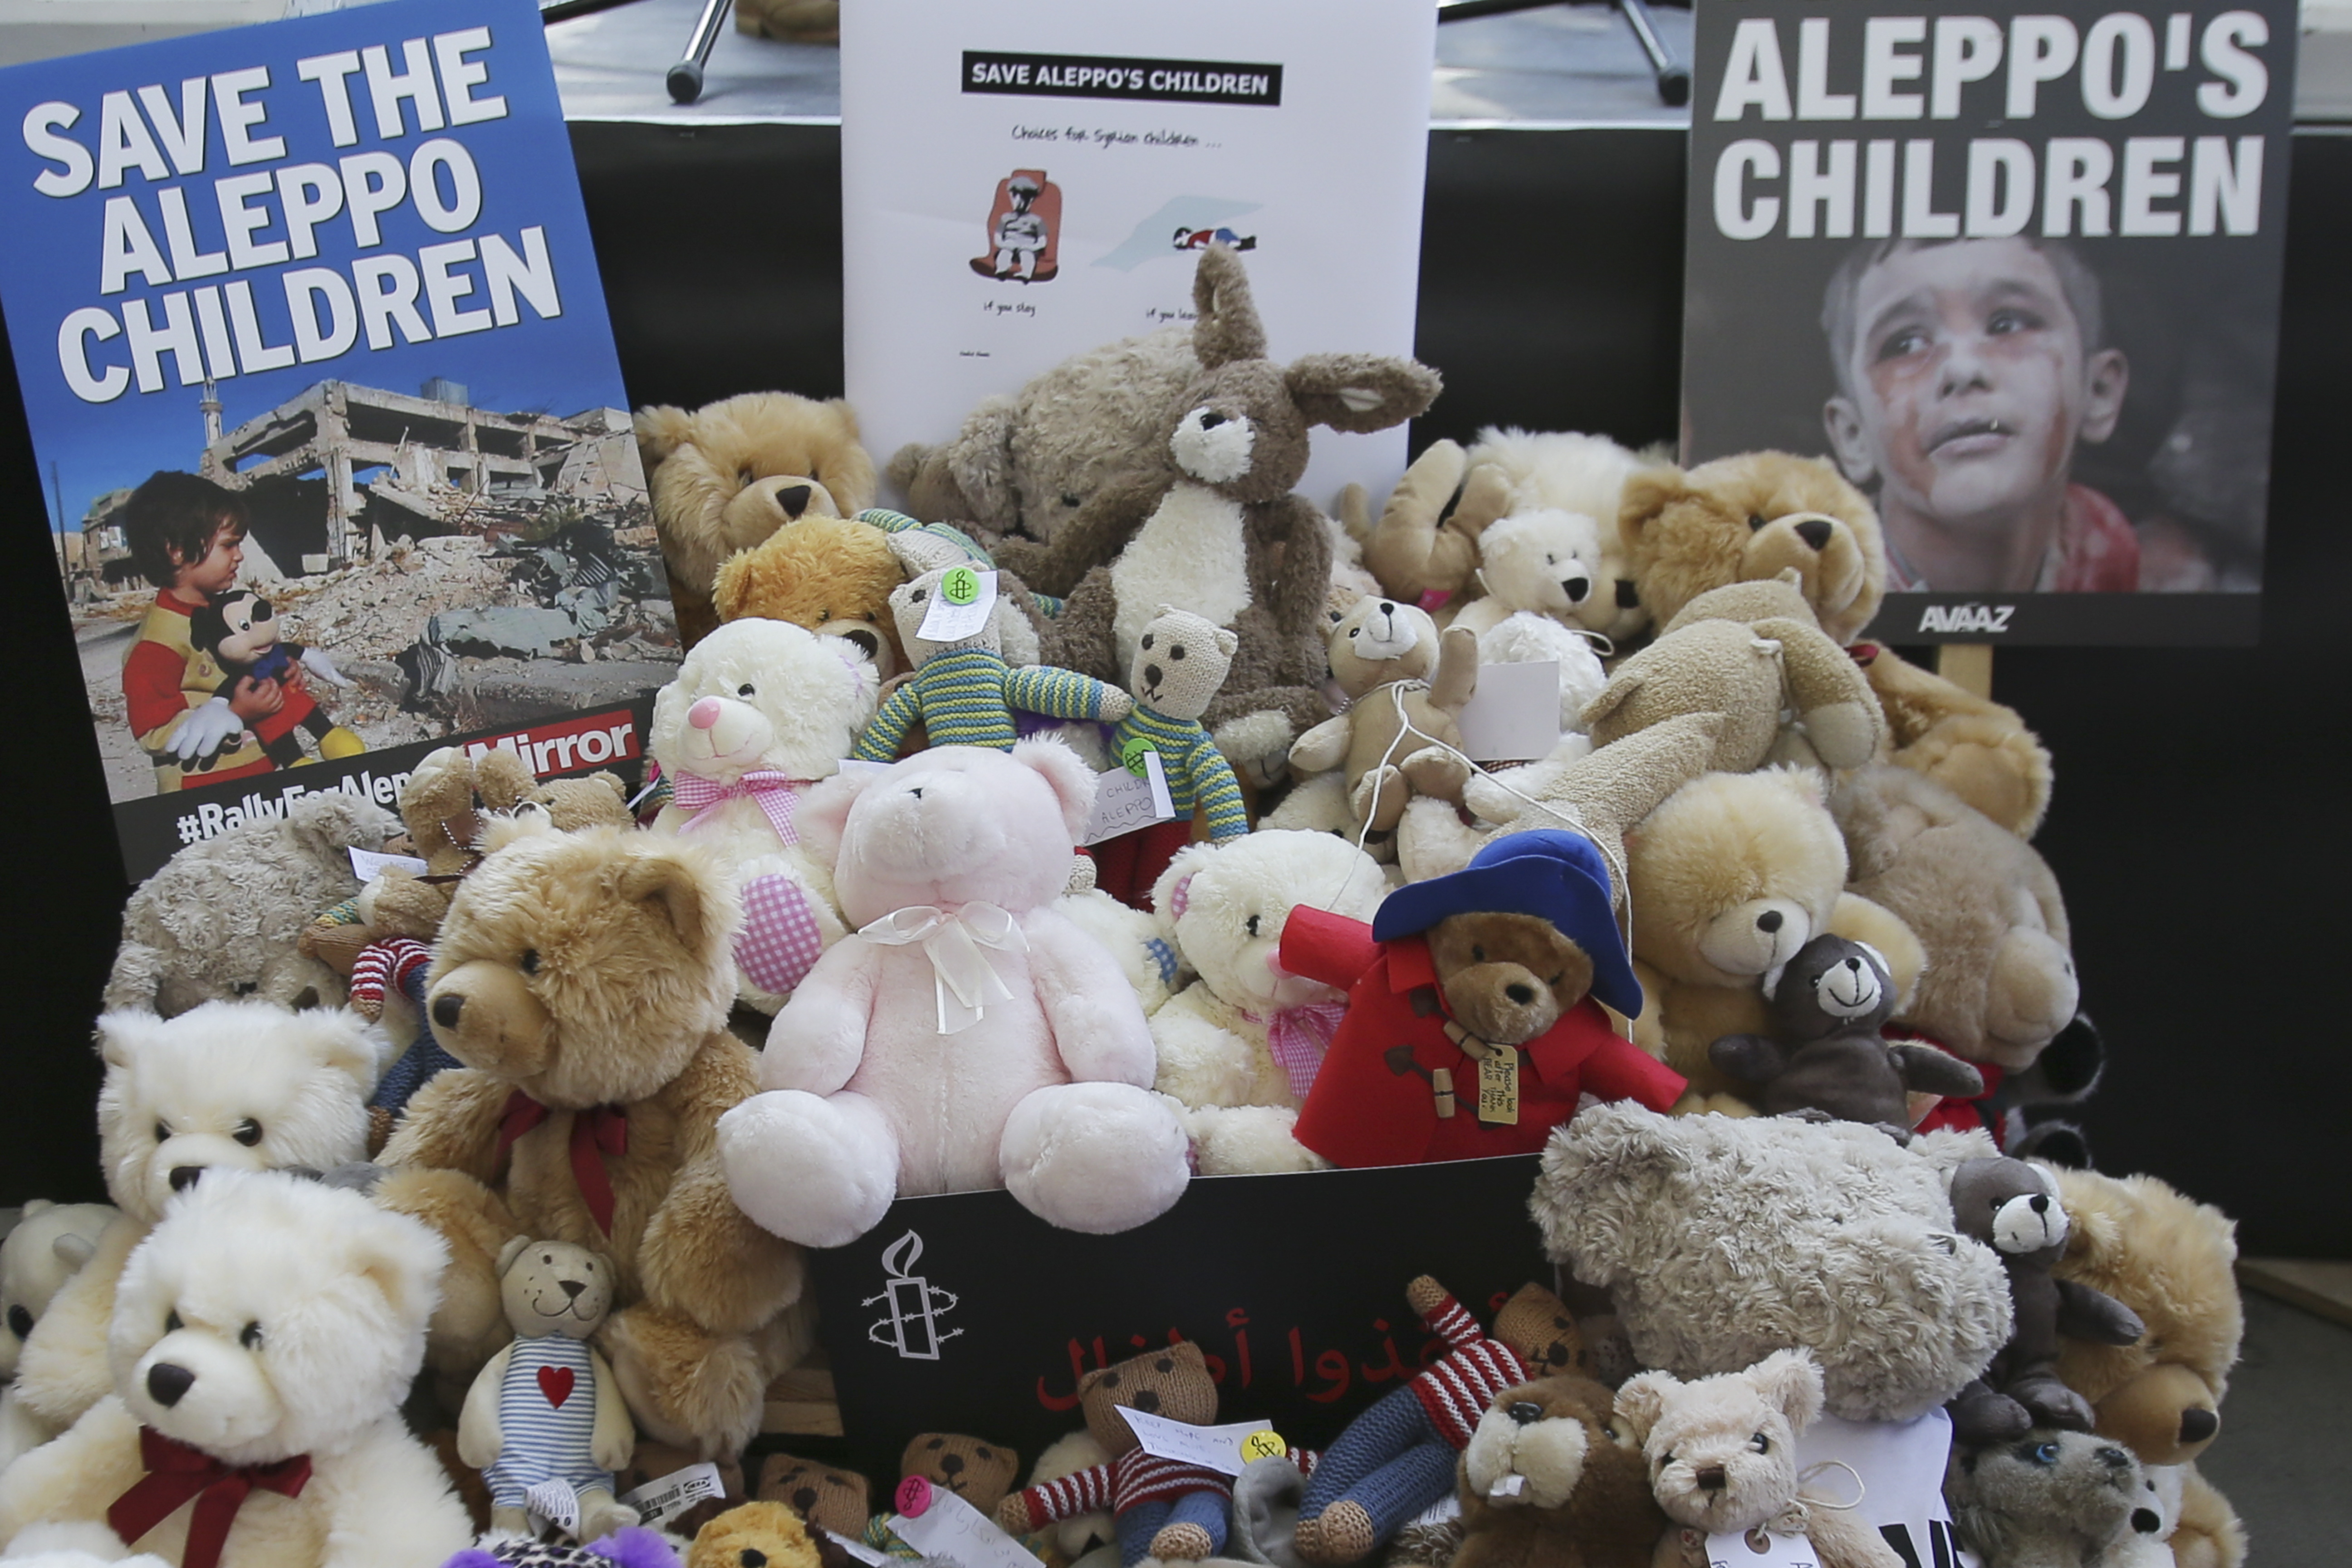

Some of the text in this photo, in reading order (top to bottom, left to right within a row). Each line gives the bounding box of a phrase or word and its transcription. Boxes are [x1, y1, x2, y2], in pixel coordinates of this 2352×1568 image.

[972, 63, 1269, 96] SAVE ALEPPO'S CHILDREN
[1713, 11, 2269, 122] ALEPPO'S
[22, 26, 509, 198] SAVE THE
[101, 137, 482, 294] ALEPPO
[1713, 136, 2265, 240] CHILDREN
[57, 225, 562, 403] CHILDREN
[1918, 605, 2016, 632] AVAAZ
[1102, 797, 1152, 824] ALEPPO
[1106, 778, 1150, 798] CHILDR
[1504, 1063, 1514, 1092] Please
